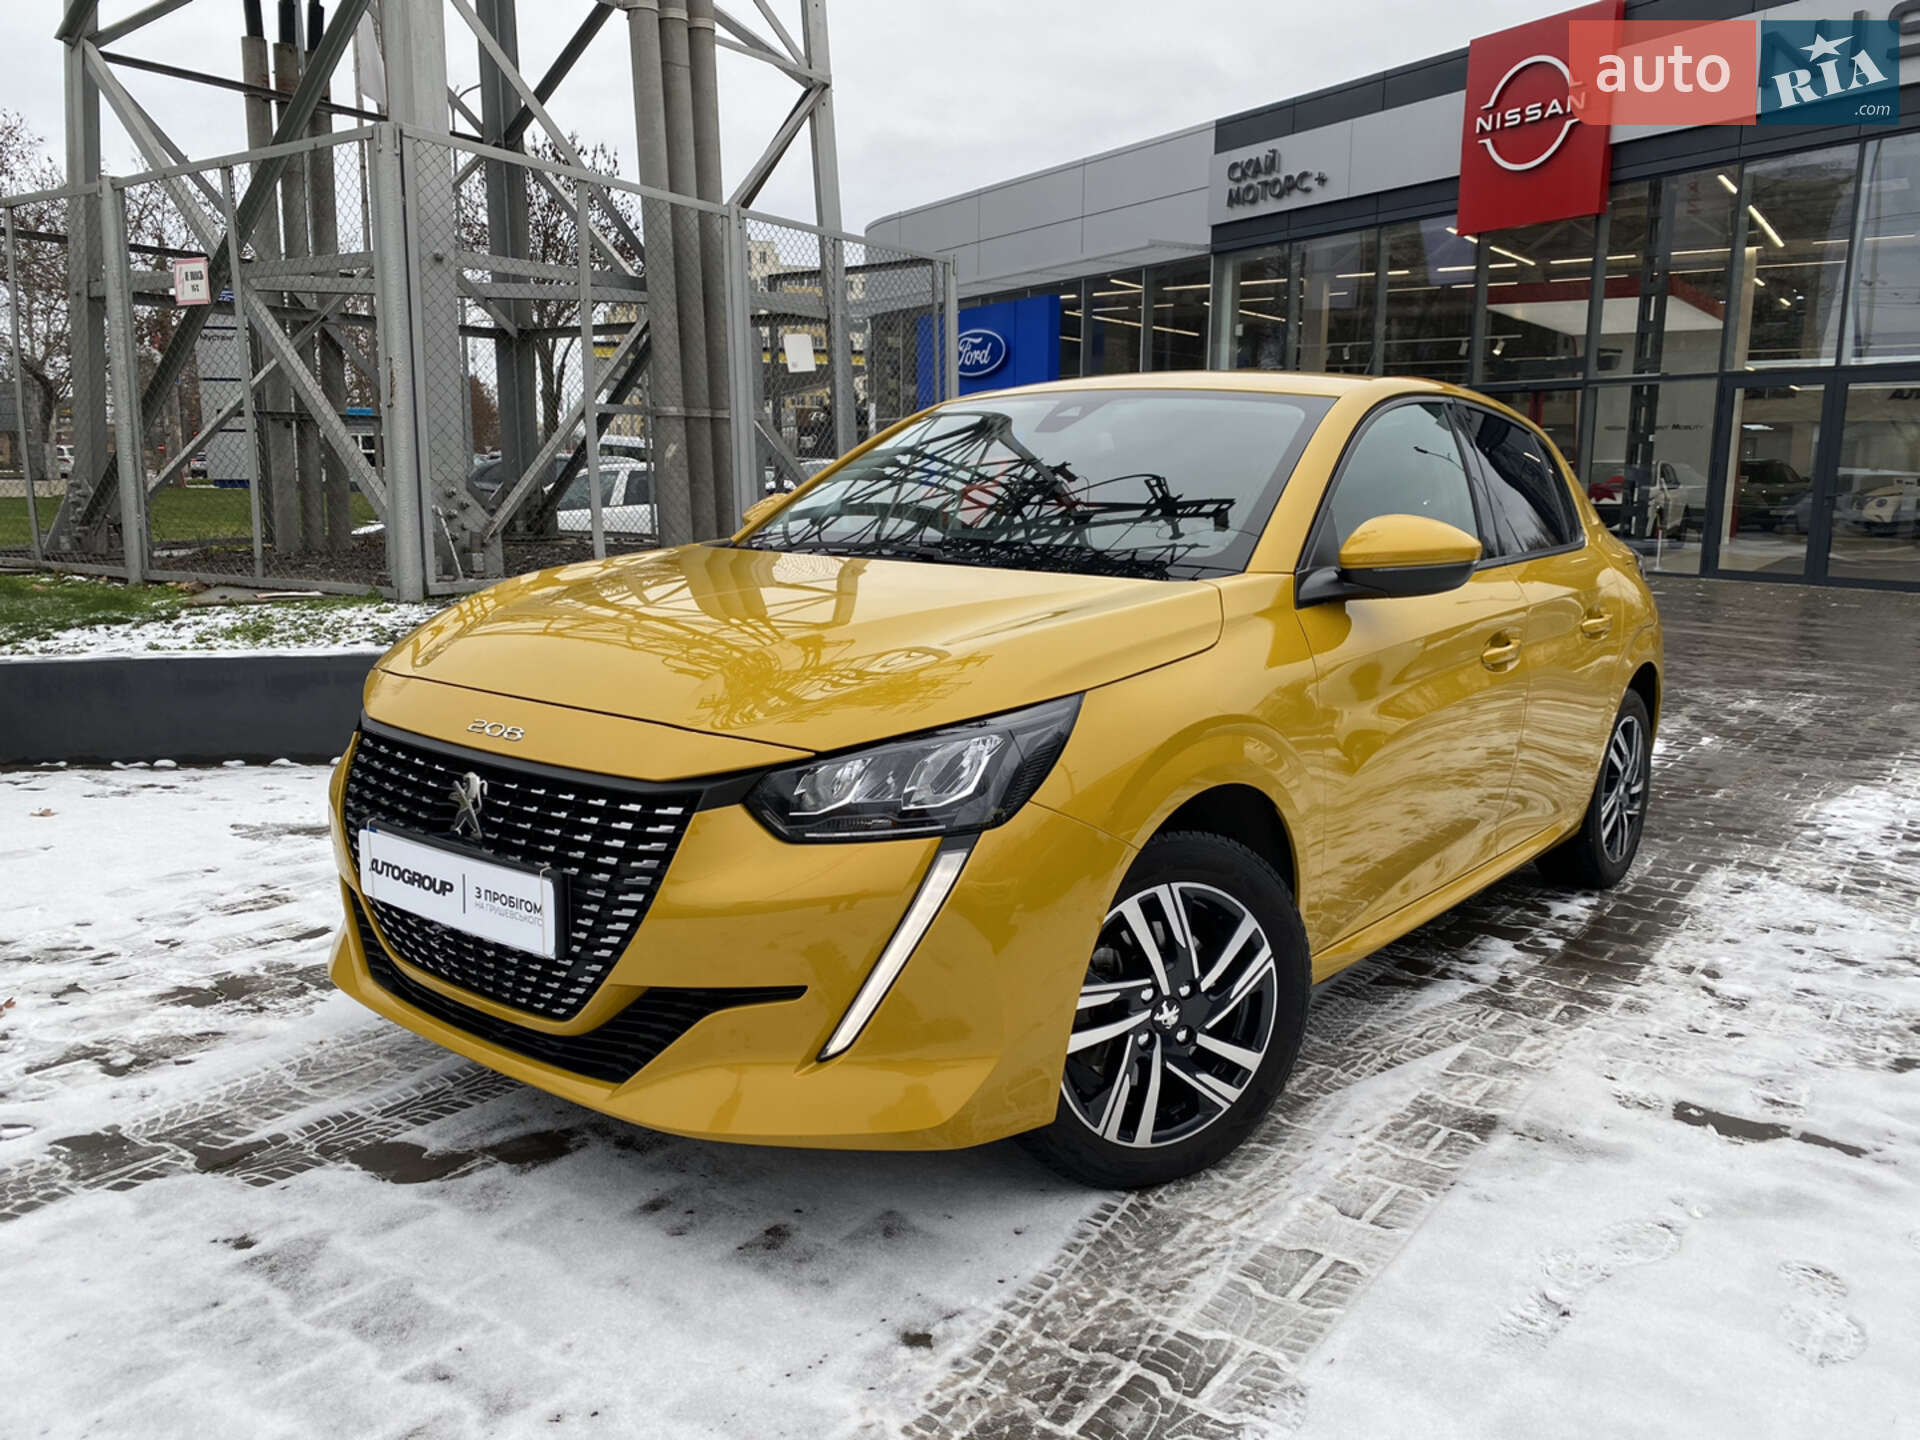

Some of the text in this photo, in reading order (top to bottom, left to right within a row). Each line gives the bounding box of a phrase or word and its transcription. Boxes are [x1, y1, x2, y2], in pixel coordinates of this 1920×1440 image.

[1475, 91, 1586, 134] NISSAN
[1227, 148, 1281, 183] СКАЙ
[958, 336, 993, 366] Ford
[467, 718, 525, 741] 208
[369, 857, 454, 896] AUTOGROUP
[484, 889, 543, 916] ПРОБІГОМ
